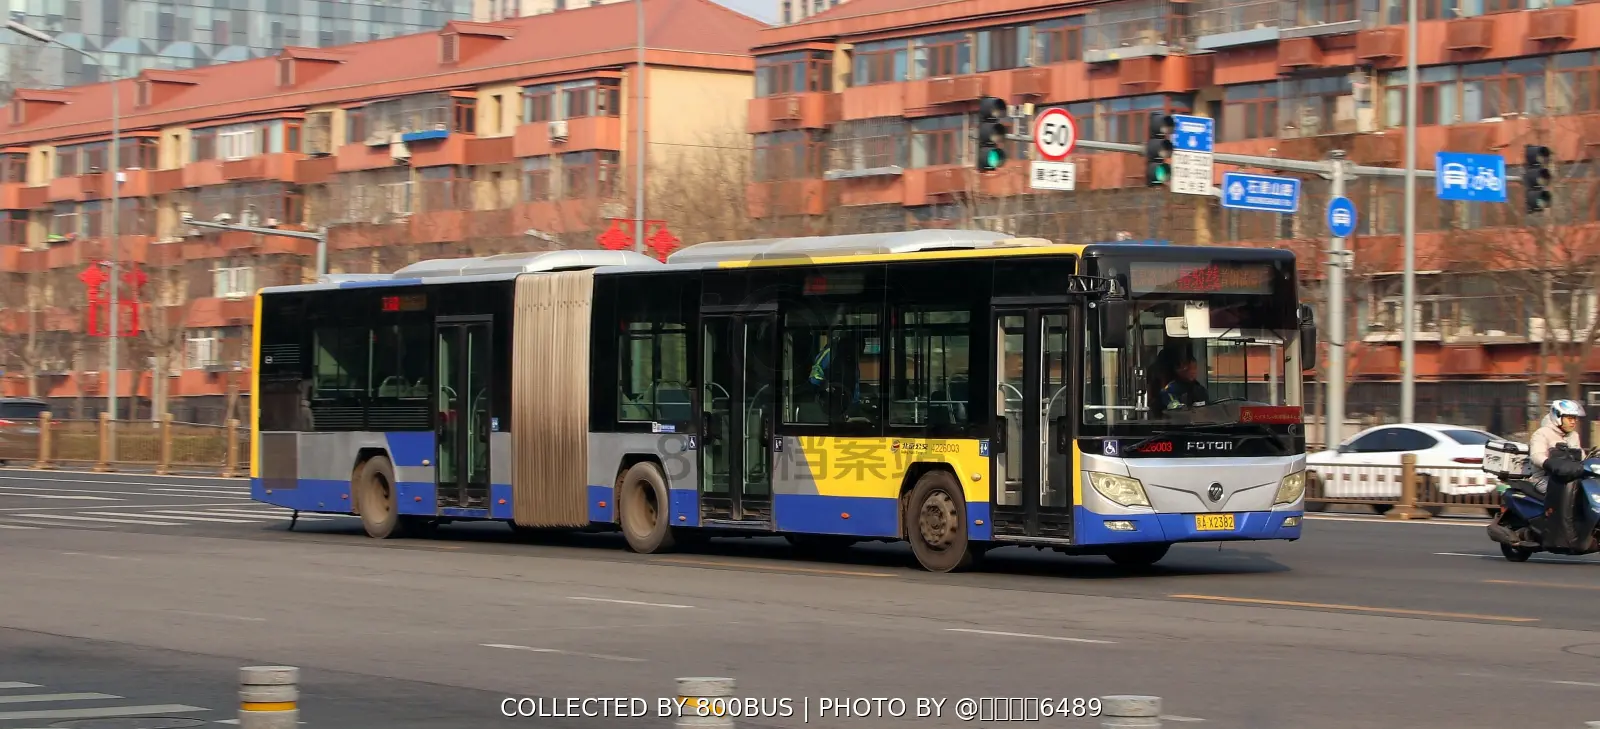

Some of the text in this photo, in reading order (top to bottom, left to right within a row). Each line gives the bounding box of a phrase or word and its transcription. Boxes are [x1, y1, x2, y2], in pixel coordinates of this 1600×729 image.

[1042, 122, 1070, 147] 50
[930, 443, 960, 454] 4226003
[1187, 441, 1233, 451] FOTON
